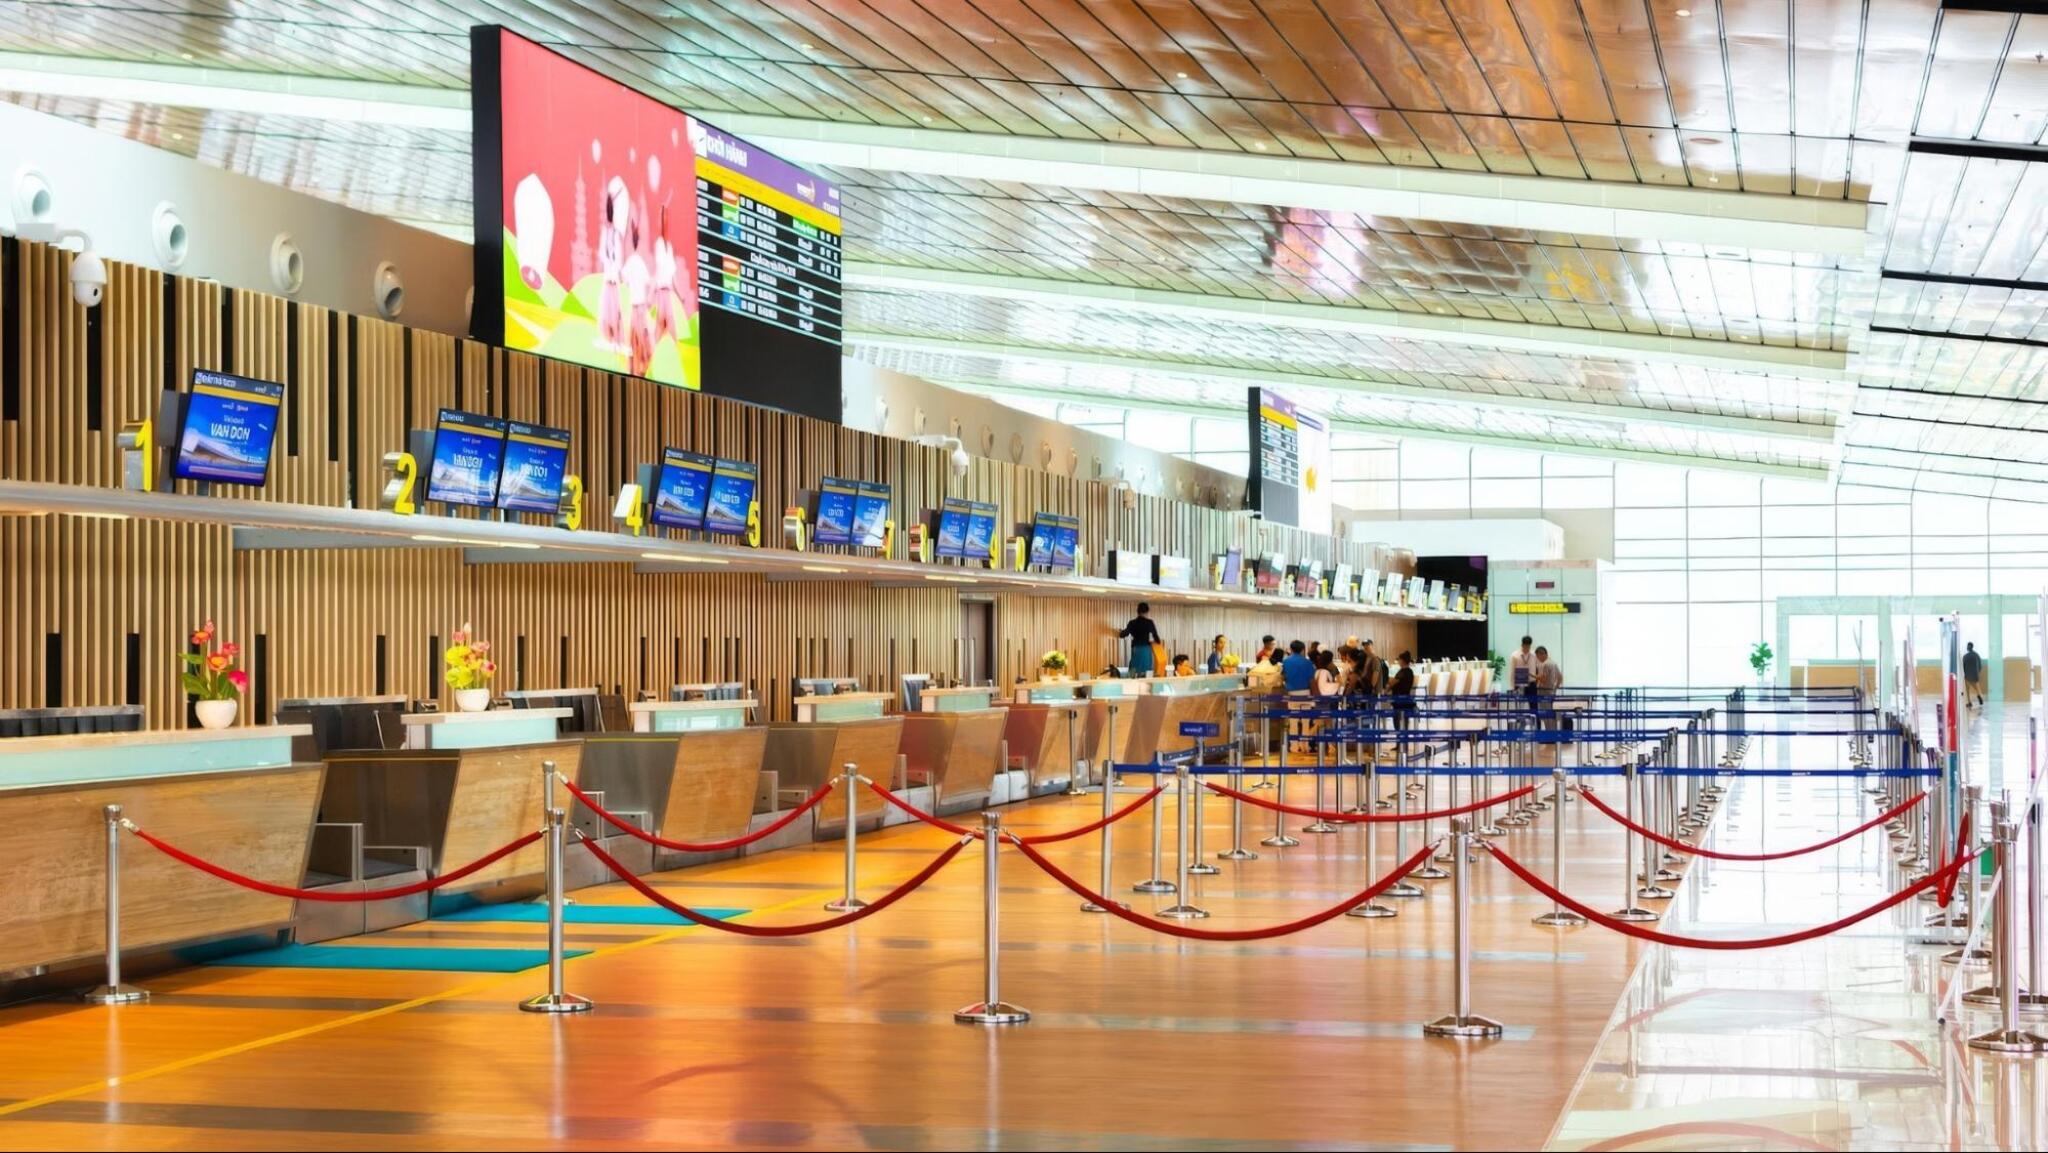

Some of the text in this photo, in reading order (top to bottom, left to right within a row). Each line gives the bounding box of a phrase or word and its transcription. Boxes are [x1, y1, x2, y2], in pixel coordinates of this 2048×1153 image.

[394, 452, 417, 515] 2
[566, 475, 583, 531] 3
[626, 484, 643, 537] 4
[748, 500, 761, 548] 5
